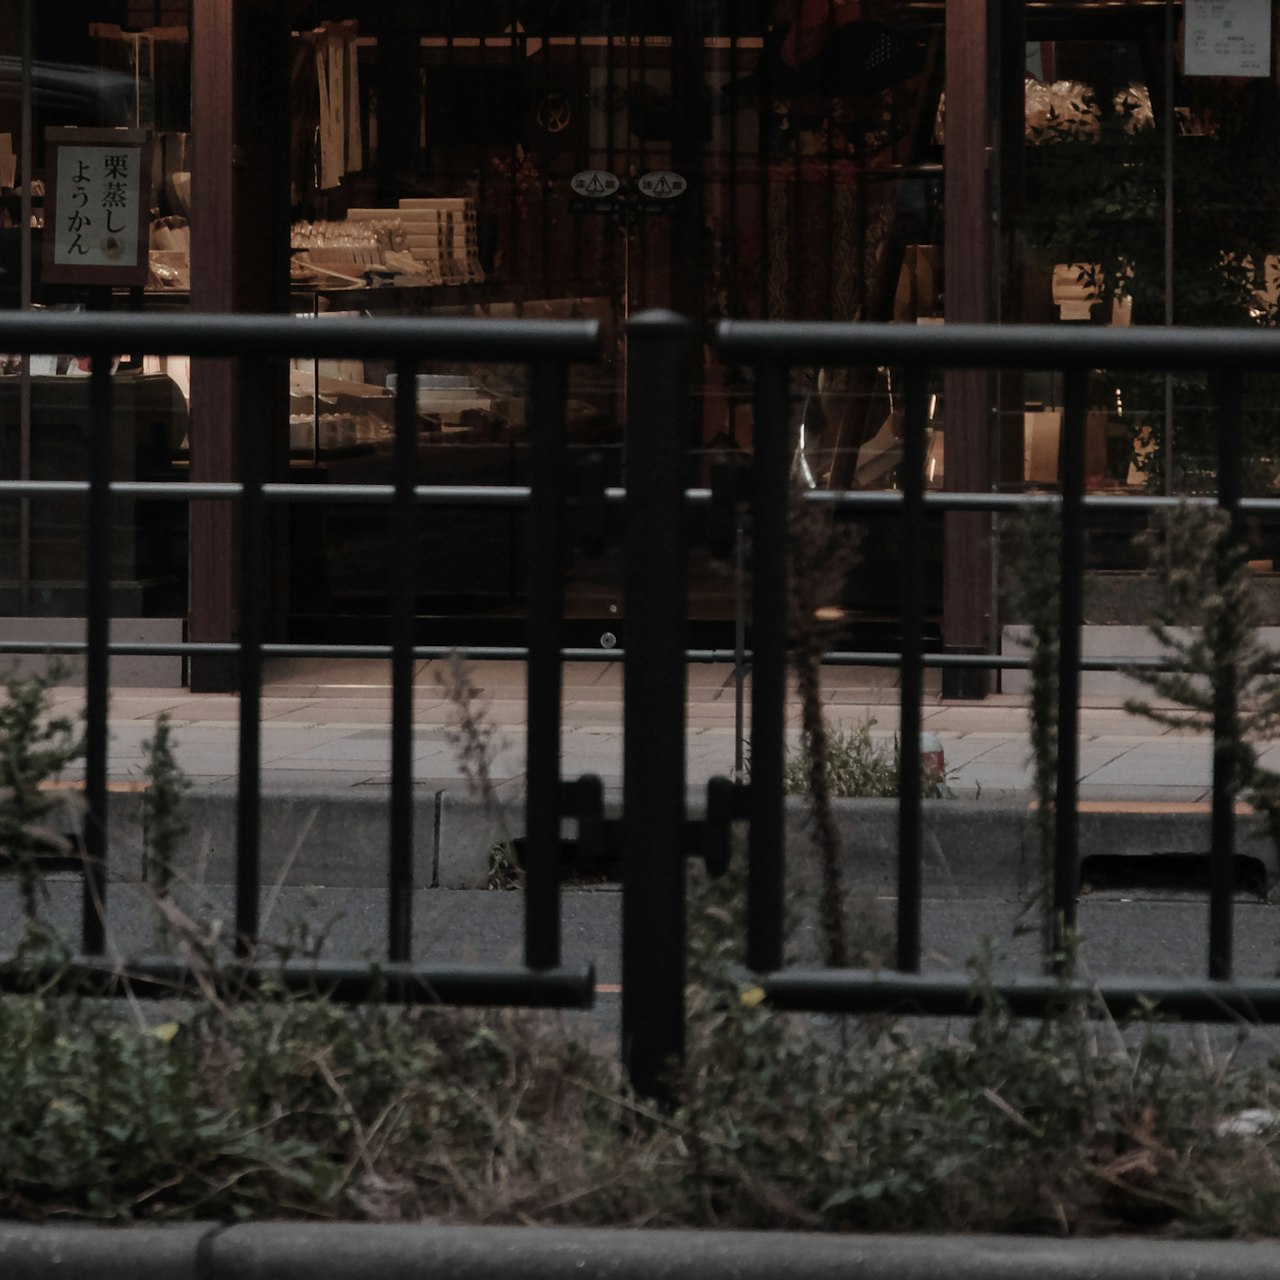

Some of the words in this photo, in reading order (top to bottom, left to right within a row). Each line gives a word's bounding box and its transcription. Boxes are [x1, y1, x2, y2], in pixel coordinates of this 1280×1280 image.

[67, 160, 91, 255] ようかん
[102, 154, 129, 234] 栗蒸し
